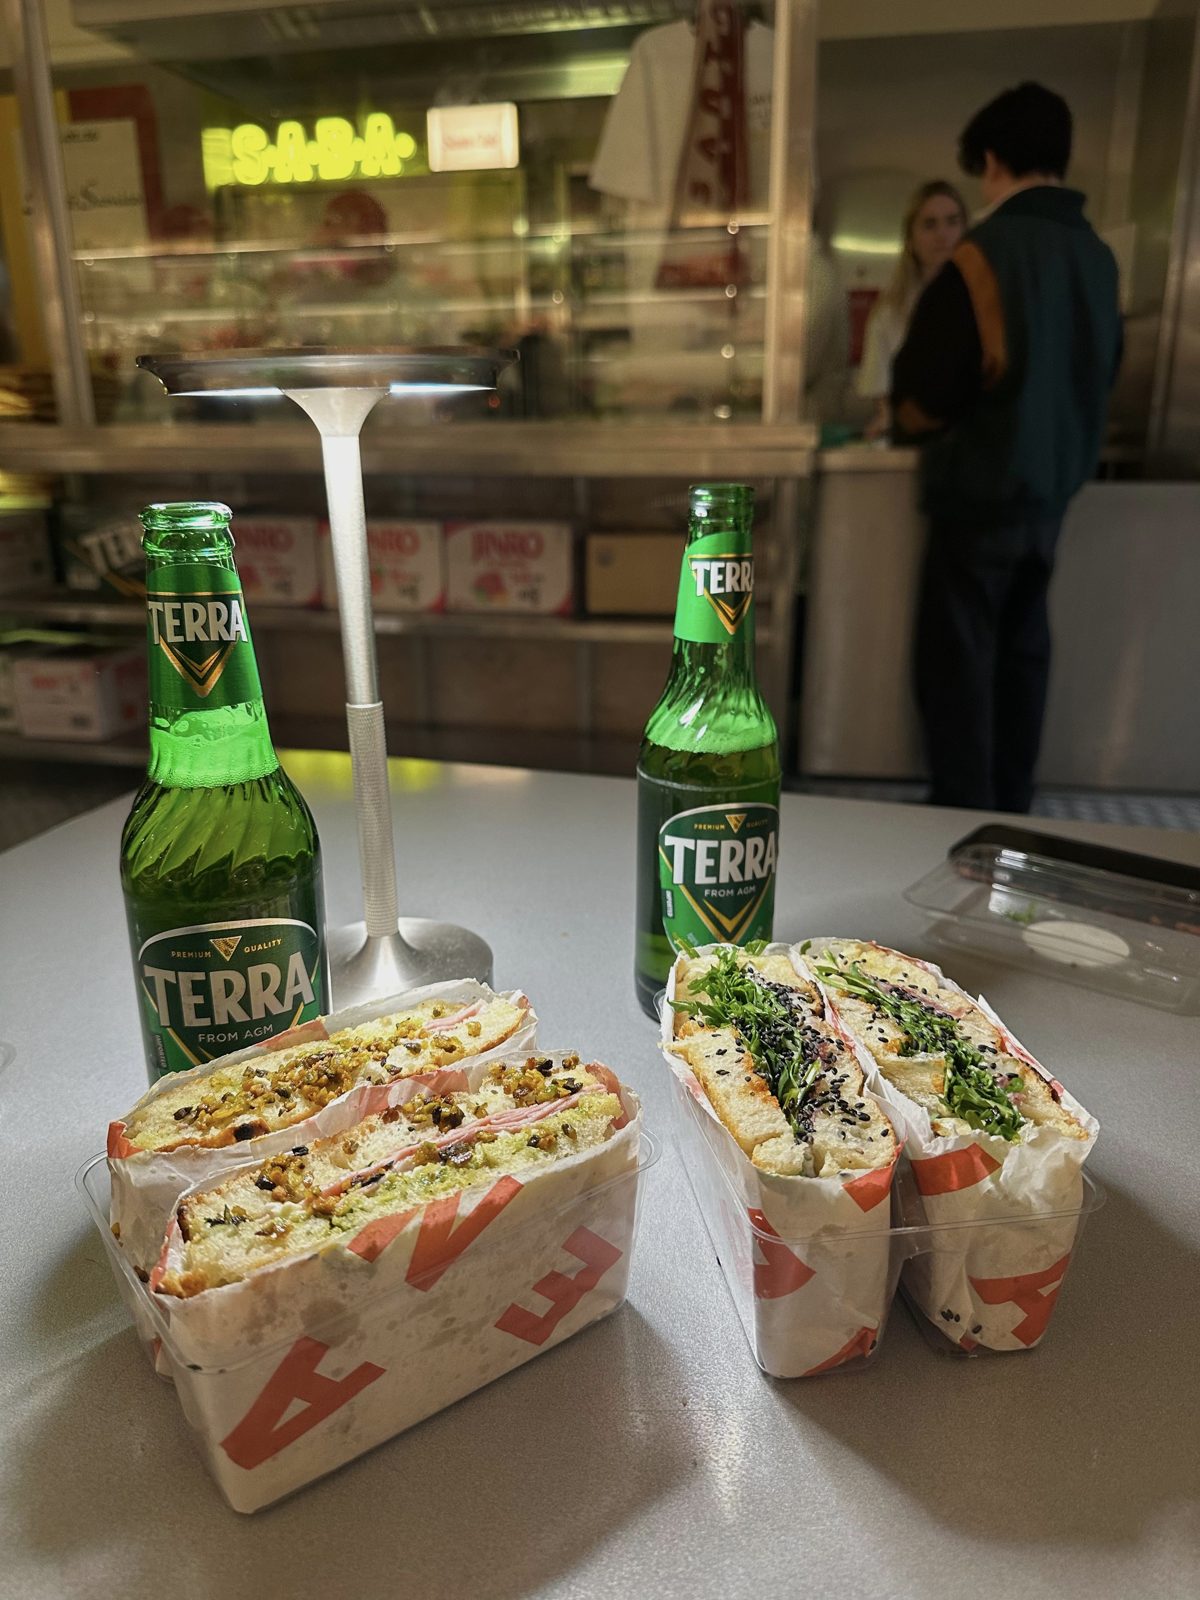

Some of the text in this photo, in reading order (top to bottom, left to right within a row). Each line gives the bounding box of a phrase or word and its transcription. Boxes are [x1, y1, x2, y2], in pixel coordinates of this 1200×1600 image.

[148, 600, 248, 645] TERRA
[693, 823, 726, 831] PREMIUM
[664, 831, 776, 885] TERRA
[704, 885, 756, 898] FROM AGM
[171, 938, 283, 959] PREMIUM QUALITY
[143, 951, 316, 1027] TERRA
[198, 1024, 274, 1043] FROM AGM
